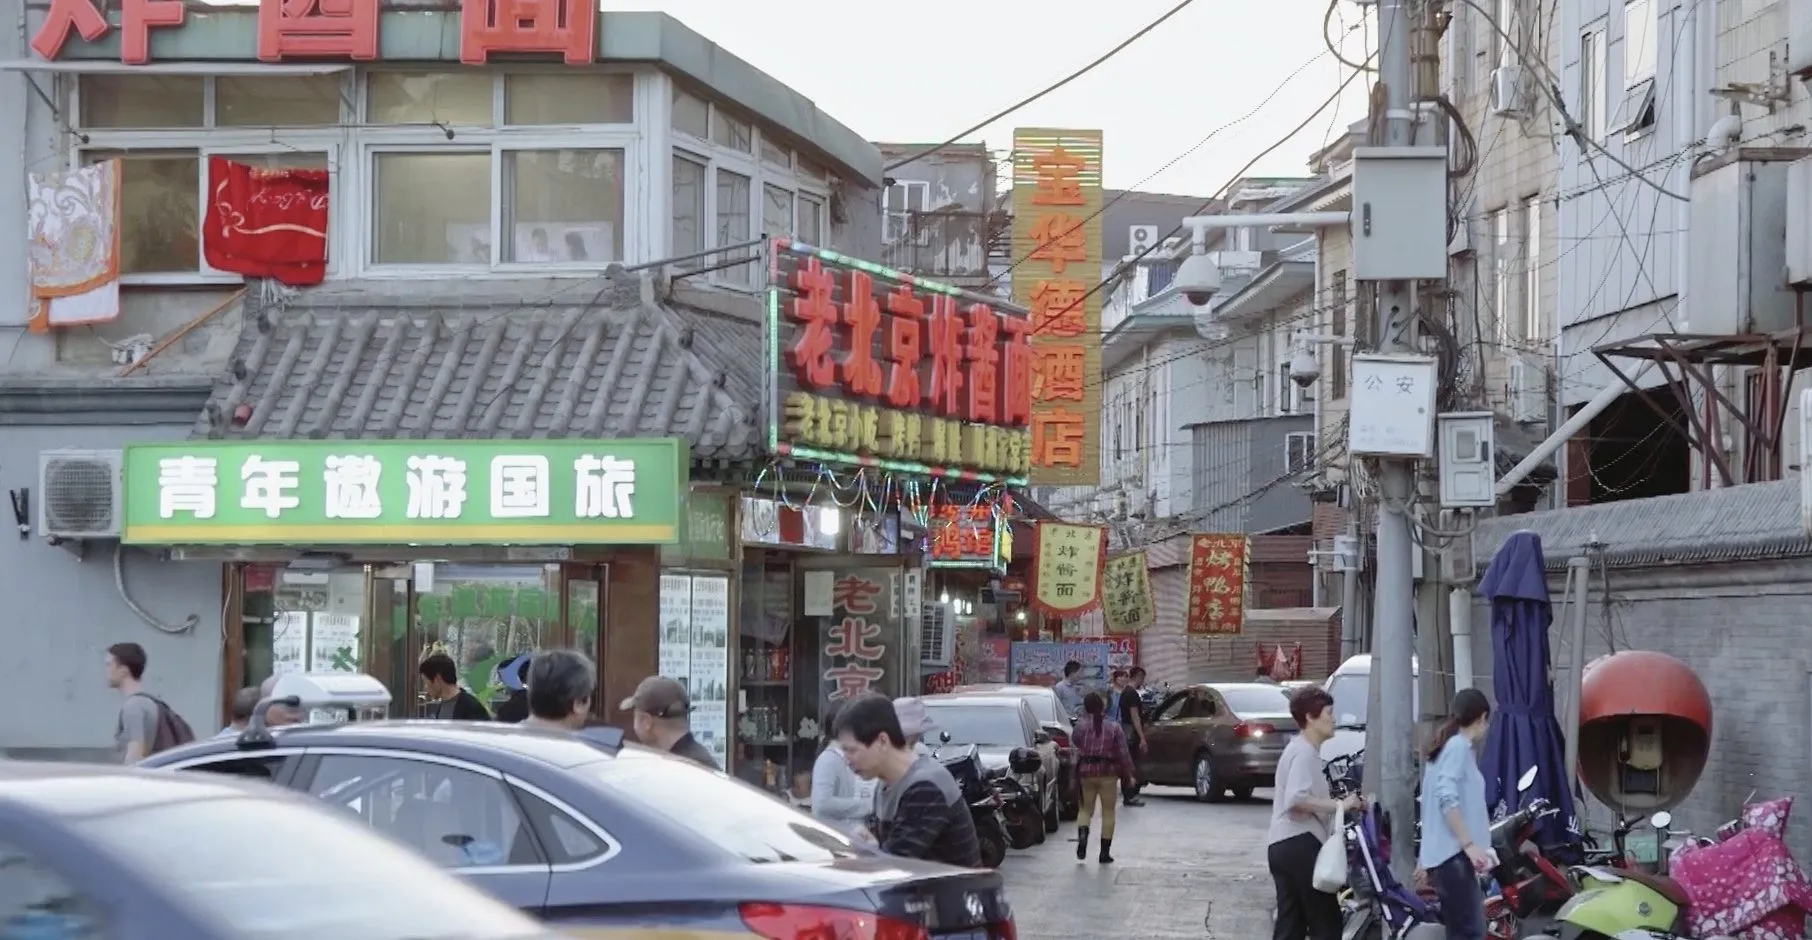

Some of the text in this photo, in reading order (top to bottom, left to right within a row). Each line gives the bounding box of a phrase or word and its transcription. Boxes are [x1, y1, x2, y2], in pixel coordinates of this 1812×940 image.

[794, 256, 1032, 426] 老北京炸酱面
[1030, 147, 1086, 467] 宝华德酒店
[1364, 374, 1415, 395] 公安
[158, 454, 636, 519] 青年遨游国旅
[824, 572, 886, 701] 老北京
